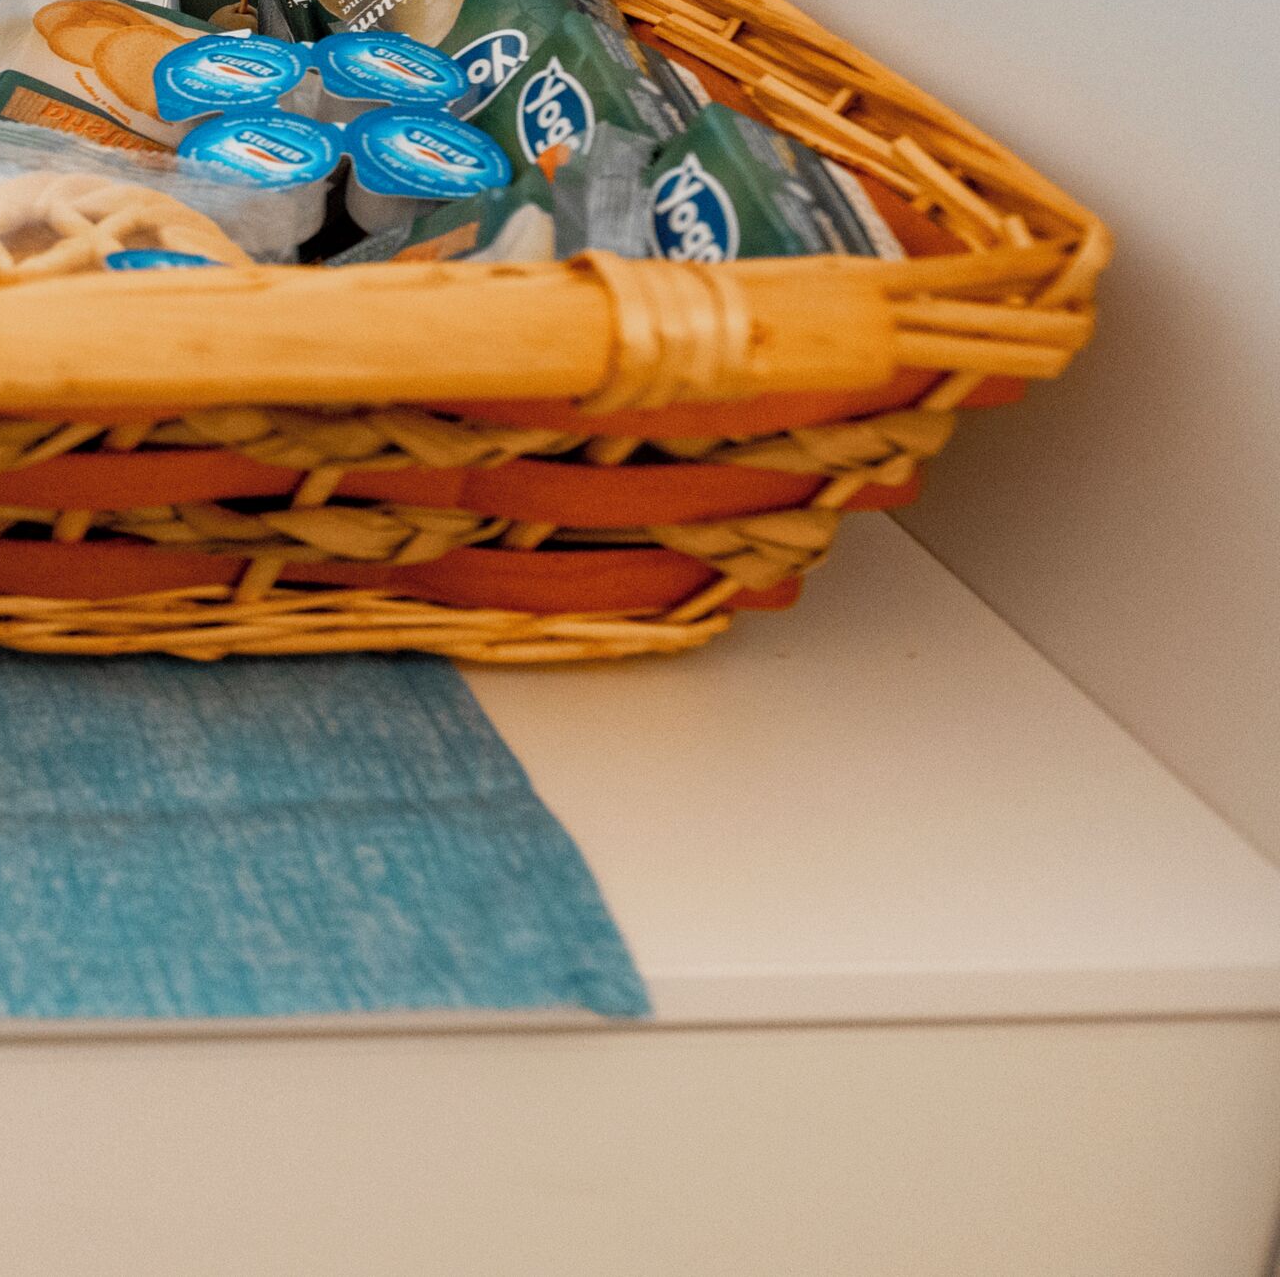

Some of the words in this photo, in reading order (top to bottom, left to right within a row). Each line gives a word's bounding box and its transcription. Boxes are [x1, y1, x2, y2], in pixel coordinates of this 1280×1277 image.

[212, 52, 275, 78] STUFFER
[374, 46, 438, 80] STUFFER
[239, 130, 304, 164] STUFFER
